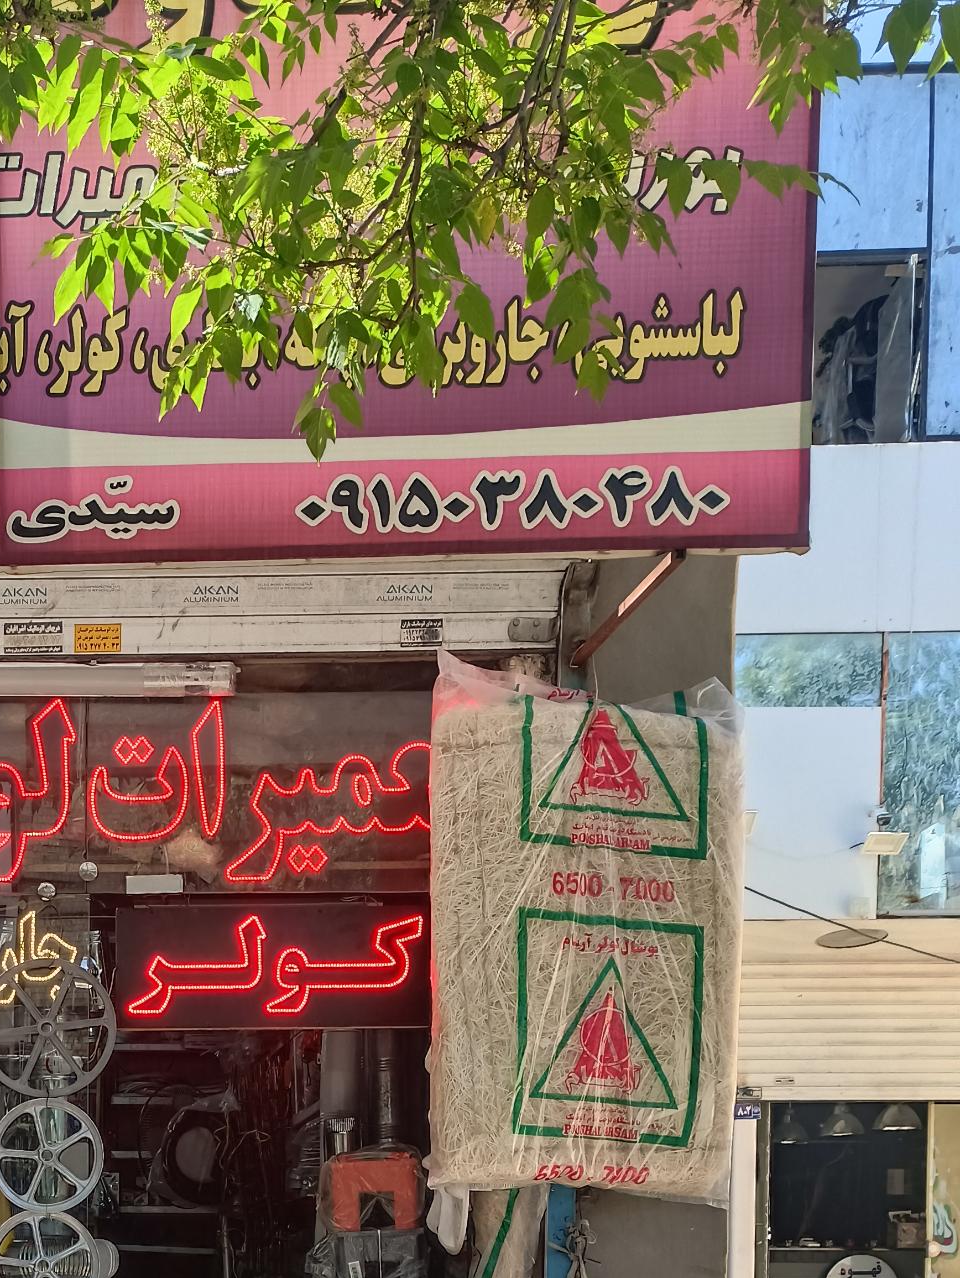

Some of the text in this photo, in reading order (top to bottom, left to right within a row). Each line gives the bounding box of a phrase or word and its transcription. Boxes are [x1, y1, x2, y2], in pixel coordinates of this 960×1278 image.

[296, 466, 730, 534] ۰۹۱۵۰۳۸۰۴۸۰
[2, 586, 47, 598] AKAN
[193, 585, 240, 596] AKAN
[386, 584, 434, 595] AKAN
[90, 699, 432, 882] عمیرات
[551, 871, 603, 898] 6500
[619, 875, 676, 903] 7000
[127, 914, 424, 1015] کولر
